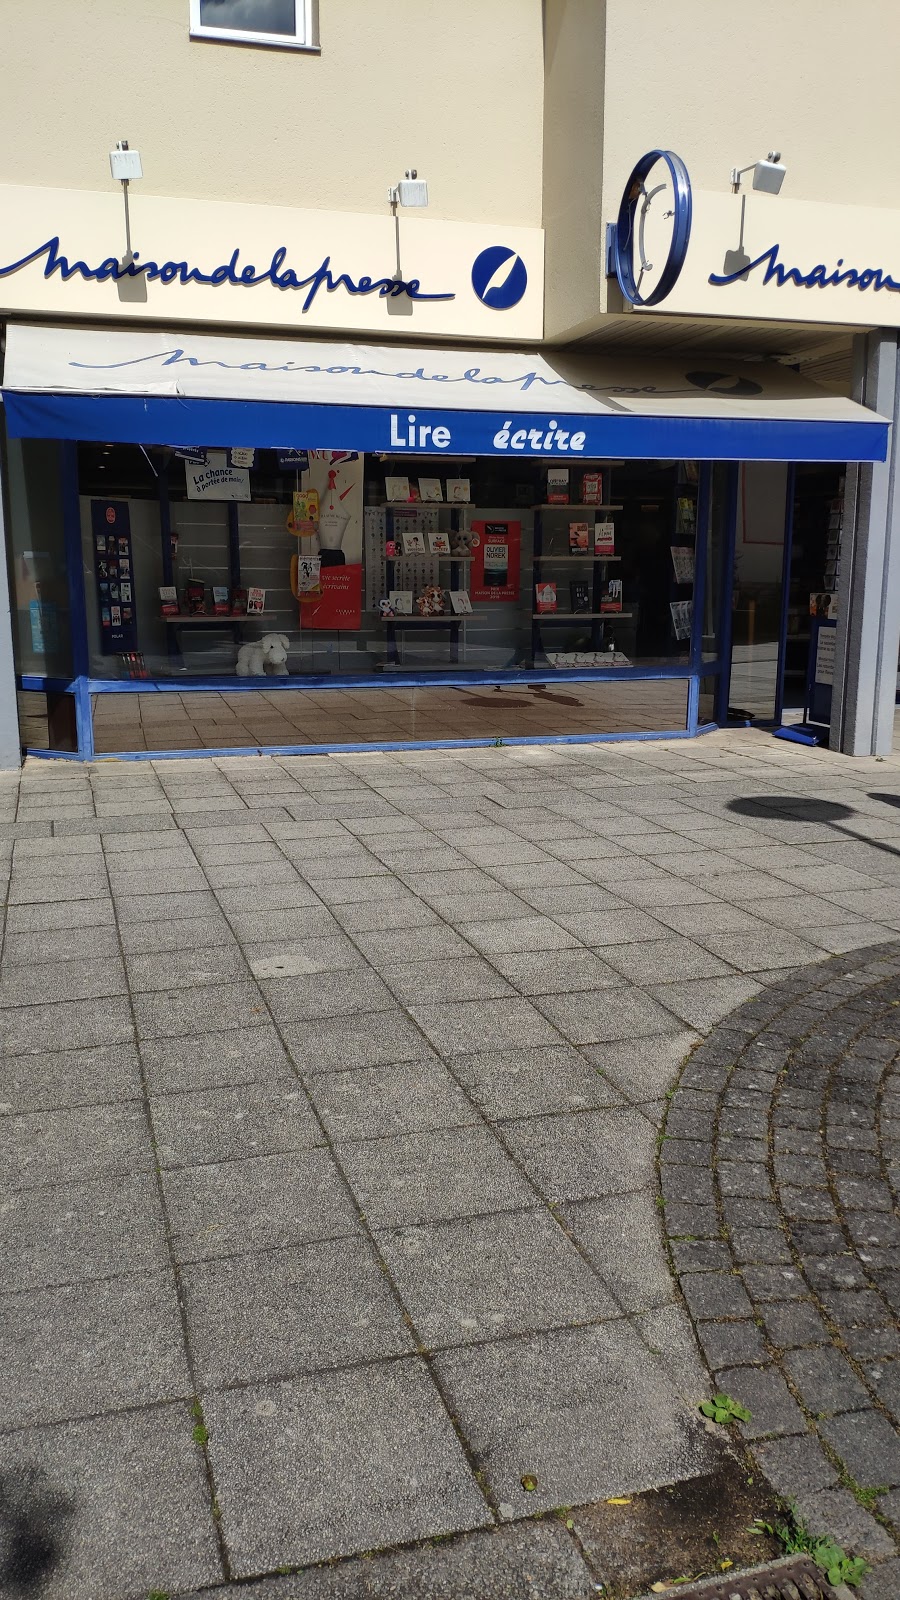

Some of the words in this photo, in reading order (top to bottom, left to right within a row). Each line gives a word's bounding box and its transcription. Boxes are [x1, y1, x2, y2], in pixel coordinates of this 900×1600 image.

[391, 414, 451, 448] Lire
[493, 415, 586, 450] écrire
[193, 474, 204, 485] La
[206, 468, 233, 479] chance
[202, 479, 220, 491] portée
[331, 574, 351, 582] secrète
